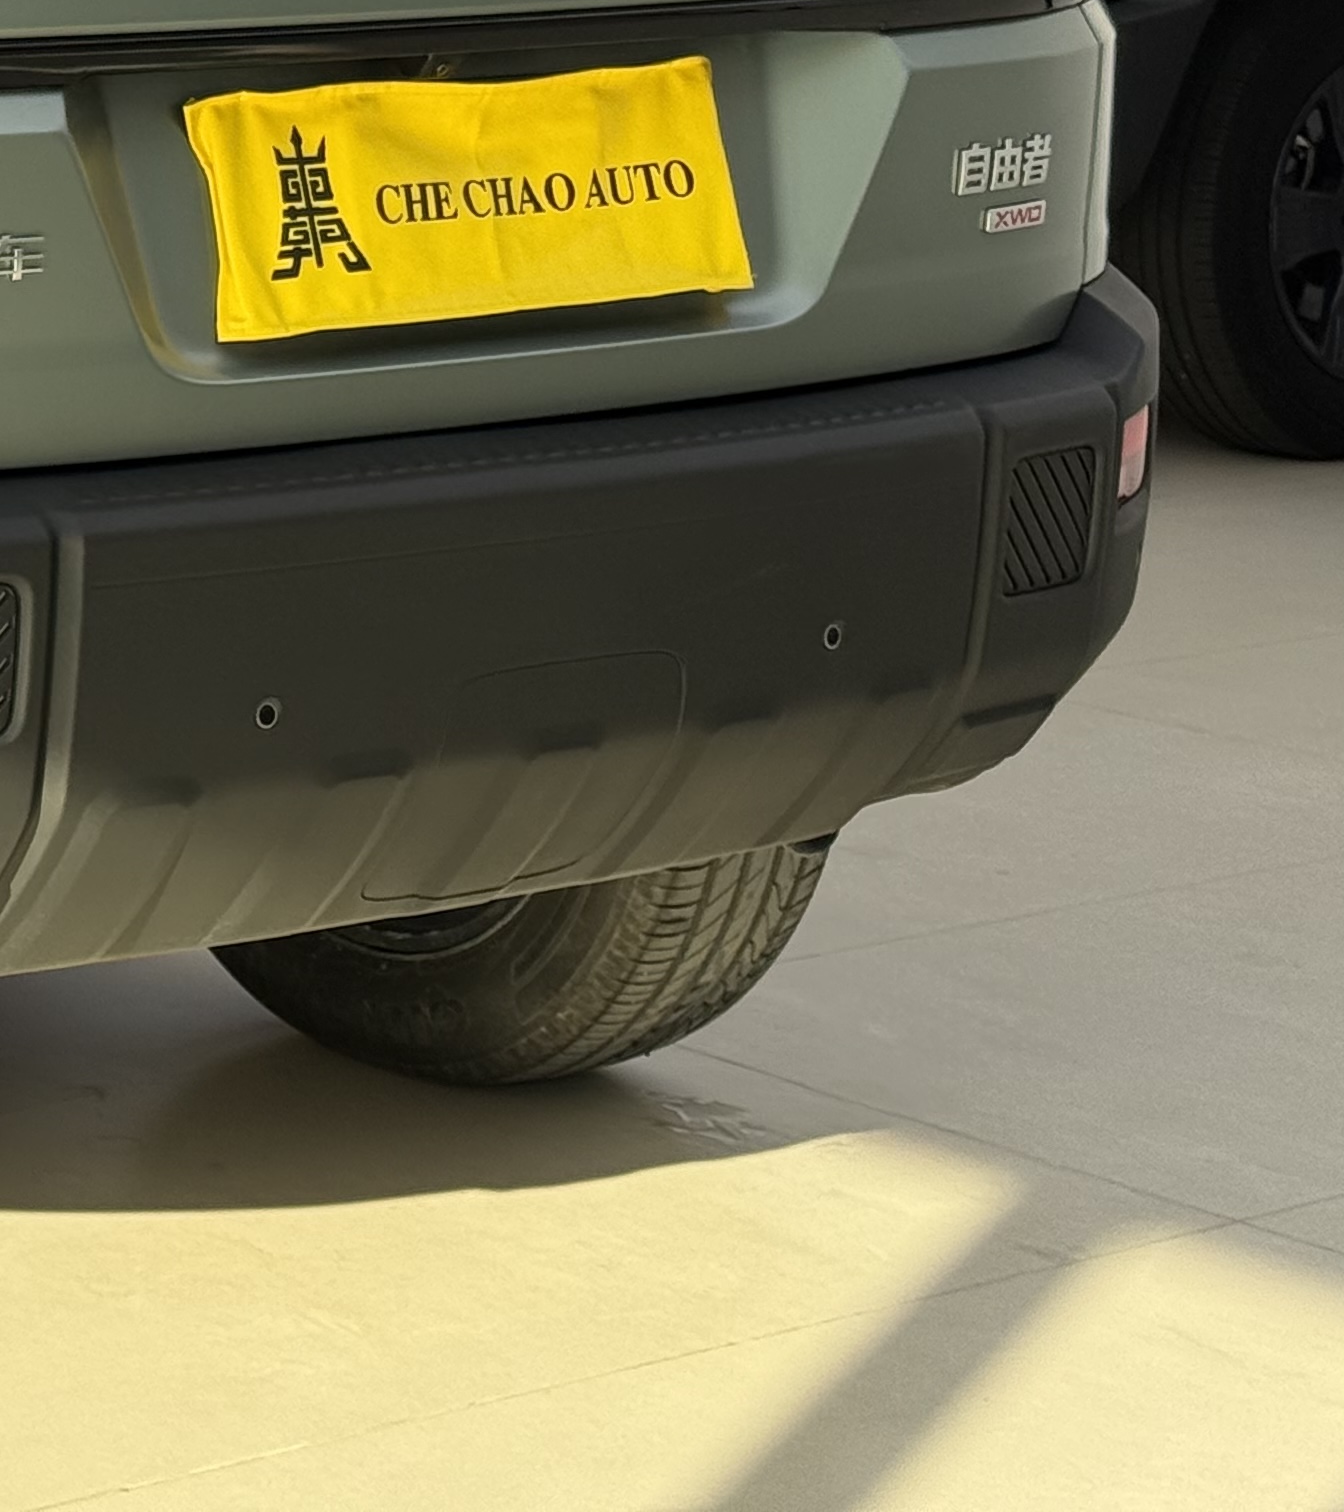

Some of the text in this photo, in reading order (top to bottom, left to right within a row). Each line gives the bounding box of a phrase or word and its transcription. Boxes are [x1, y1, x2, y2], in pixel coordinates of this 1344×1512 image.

[376, 160, 695, 224] CHE CHAO AUTO
[957, 133, 1052, 196] 自由者
[995, 205, 1042, 229] XWD
